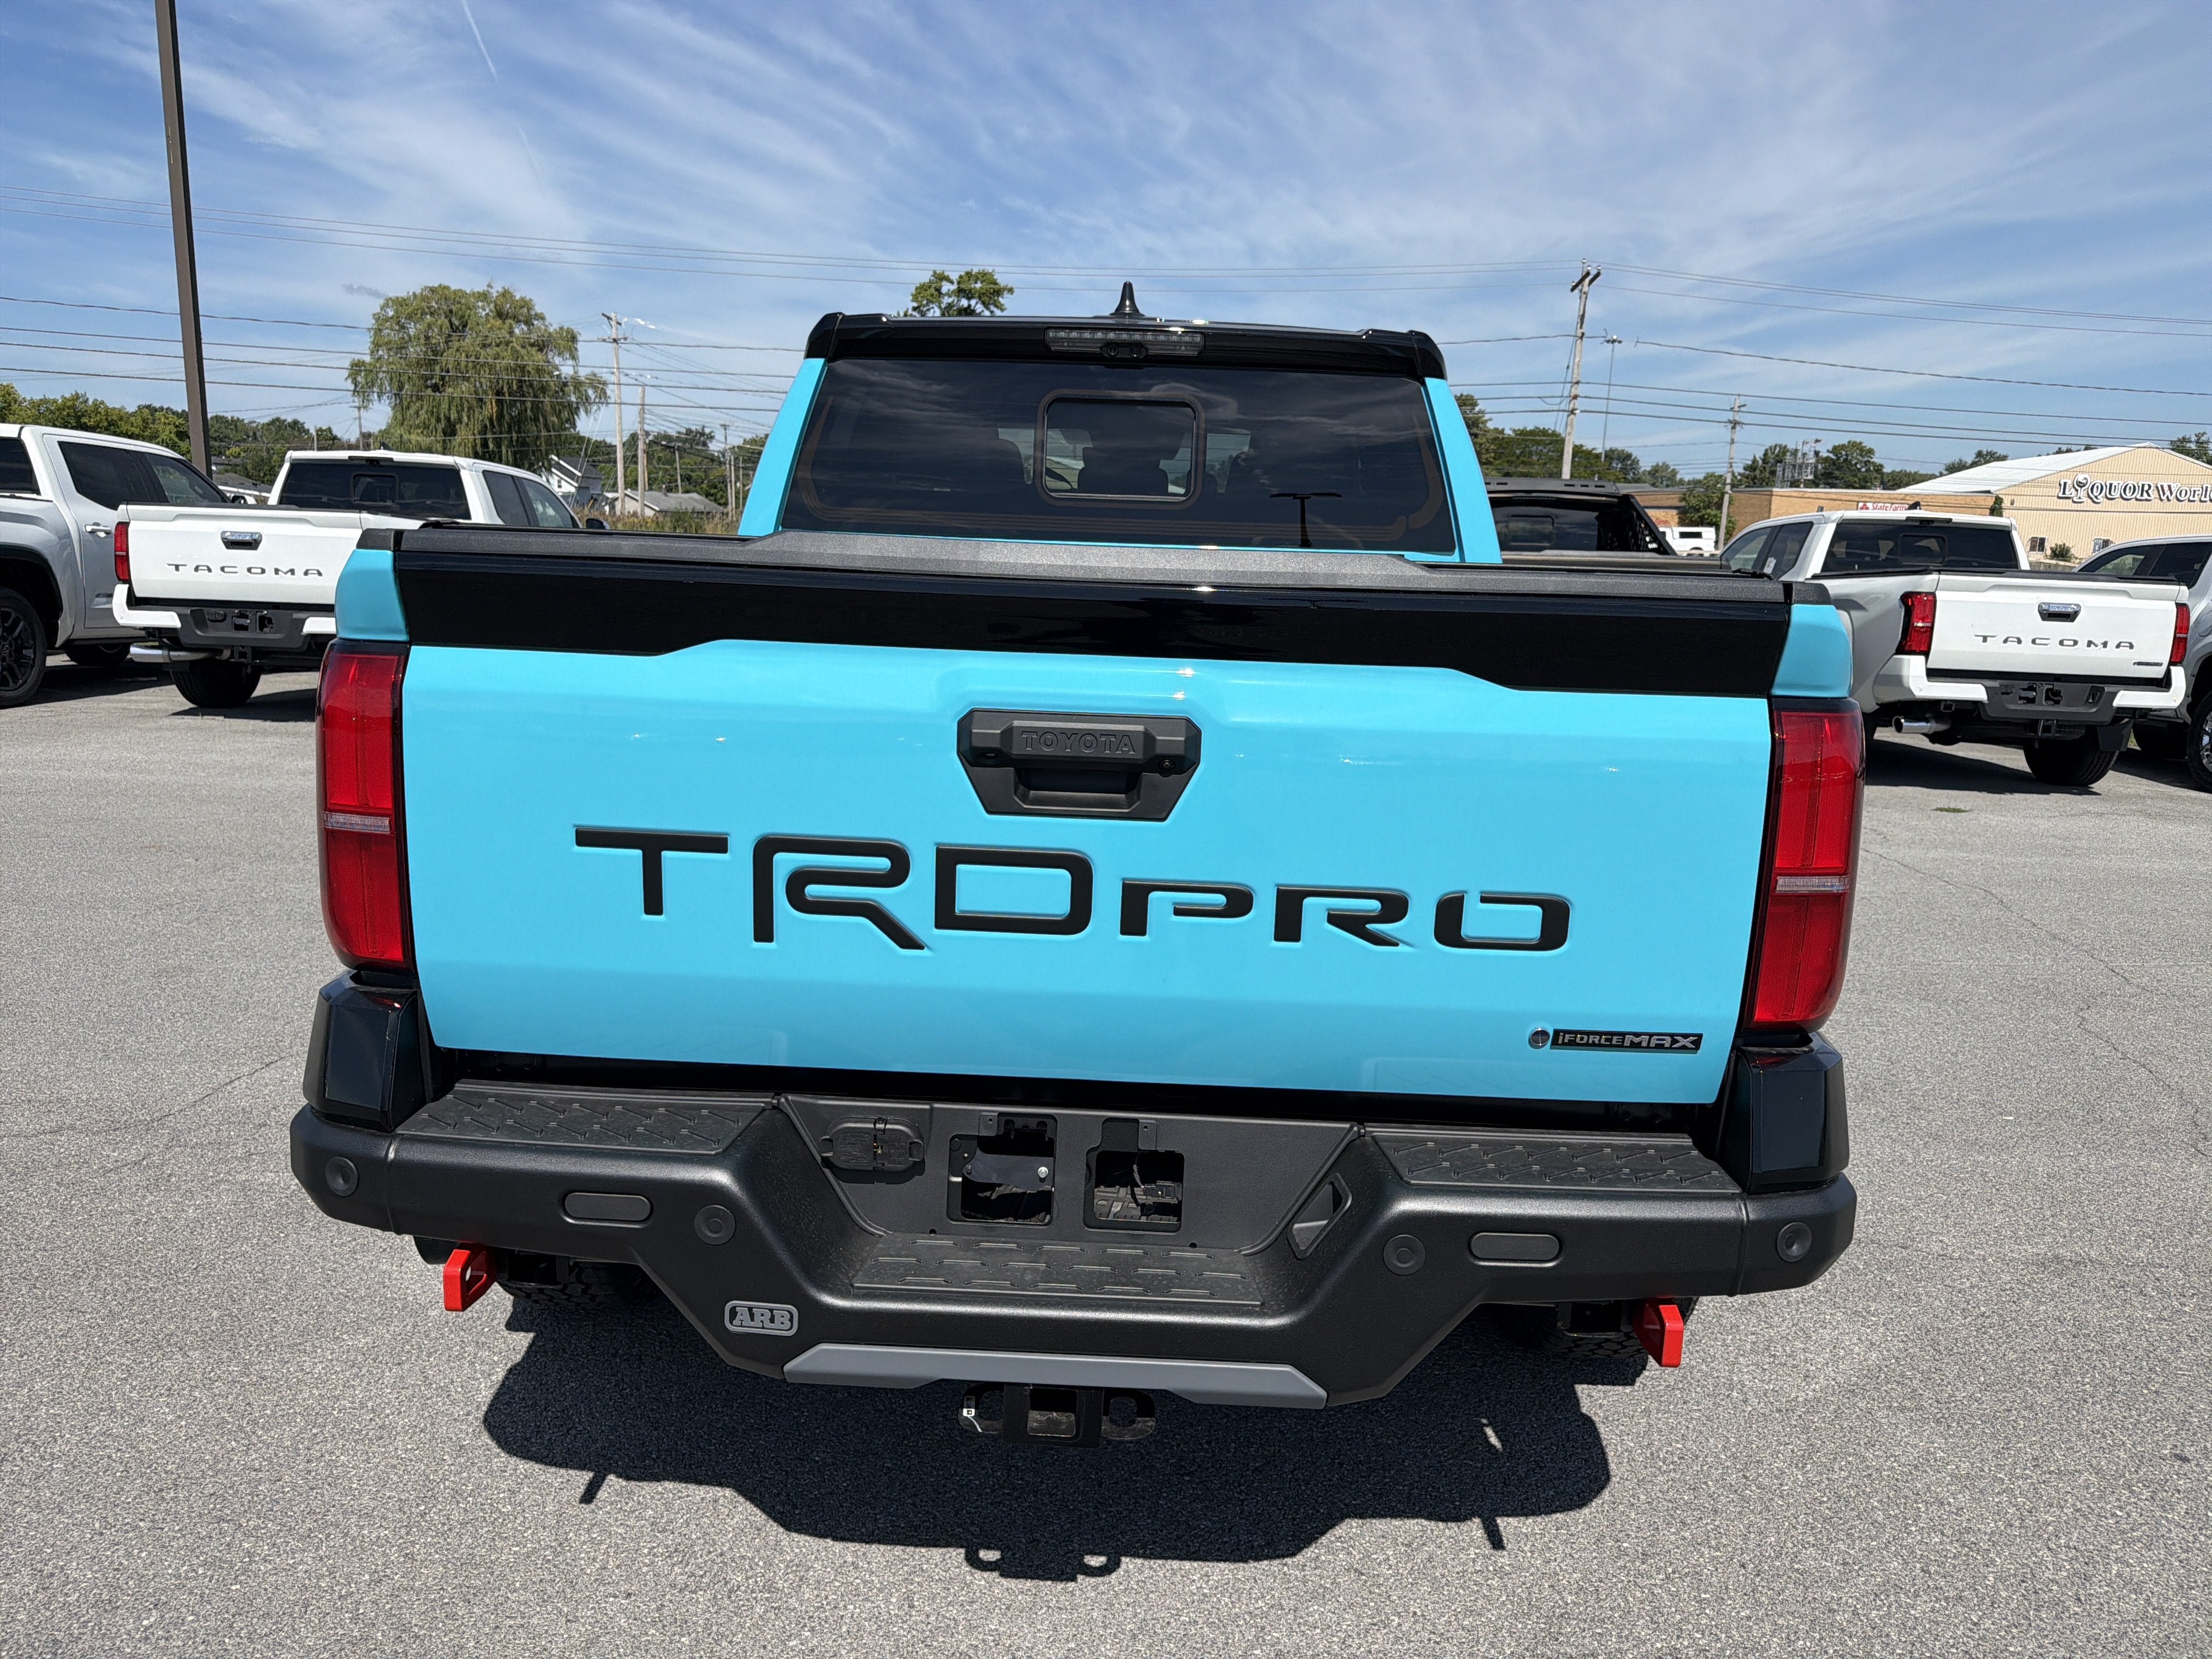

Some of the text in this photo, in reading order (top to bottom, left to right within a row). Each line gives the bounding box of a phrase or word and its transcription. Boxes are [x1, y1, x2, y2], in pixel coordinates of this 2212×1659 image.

[2157, 482, 2212, 503] Worl
[166, 563, 323, 577] TACOMA
[1974, 634, 2134, 650] TACOMA
[1021, 731, 1136, 754] TOYOTA
[574, 826, 1571, 952] TRD PRO
[732, 1307, 791, 1330] ARB
